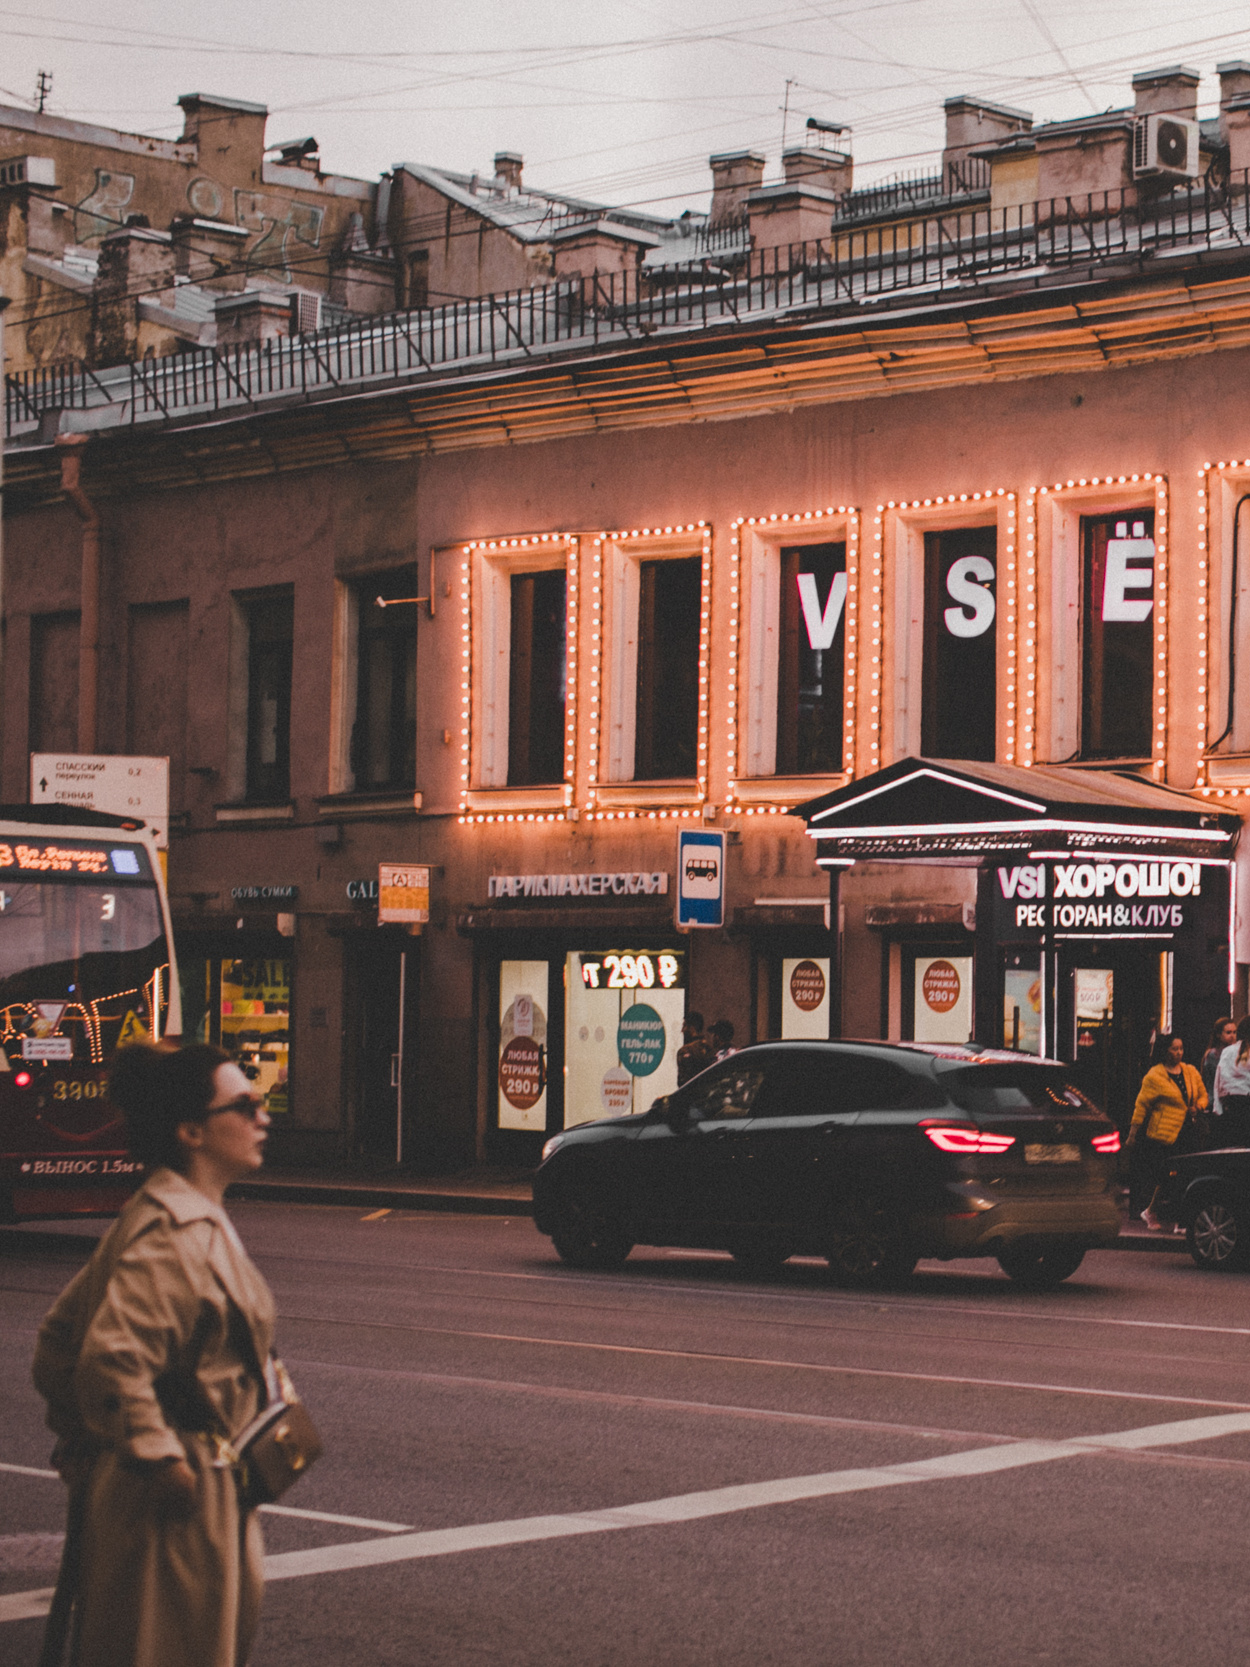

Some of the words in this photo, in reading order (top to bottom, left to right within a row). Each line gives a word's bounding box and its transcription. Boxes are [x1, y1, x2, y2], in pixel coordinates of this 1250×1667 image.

[55, 762, 106, 772] СПАССКИЙ
[55, 791, 94, 800] СЕННАЯ
[488, 873, 664, 897] ПАРИКМАХЕРСКАЯ
[1053, 863, 1201, 898] ХОРОШО!
[231, 886, 259, 899] ОБУВЬ
[261, 886, 292, 898] СУМКИ
[603, 955, 655, 988] 290
[796, 991, 814, 1000] 290
[928, 991, 948, 1001] 290
[620, 1021, 663, 1031] МАНИКЮР
[621, 1039, 661, 1049] ГЕЛЬ-ЛАК
[507, 1050, 539, 1061] ЛЮБАЯ
[629, 1052, 647, 1064] 770
[501, 1064, 540, 1075] СТРИЖК
[506, 1079, 531, 1094] 290
[33, 1160, 98, 1174] ВЫНОС
